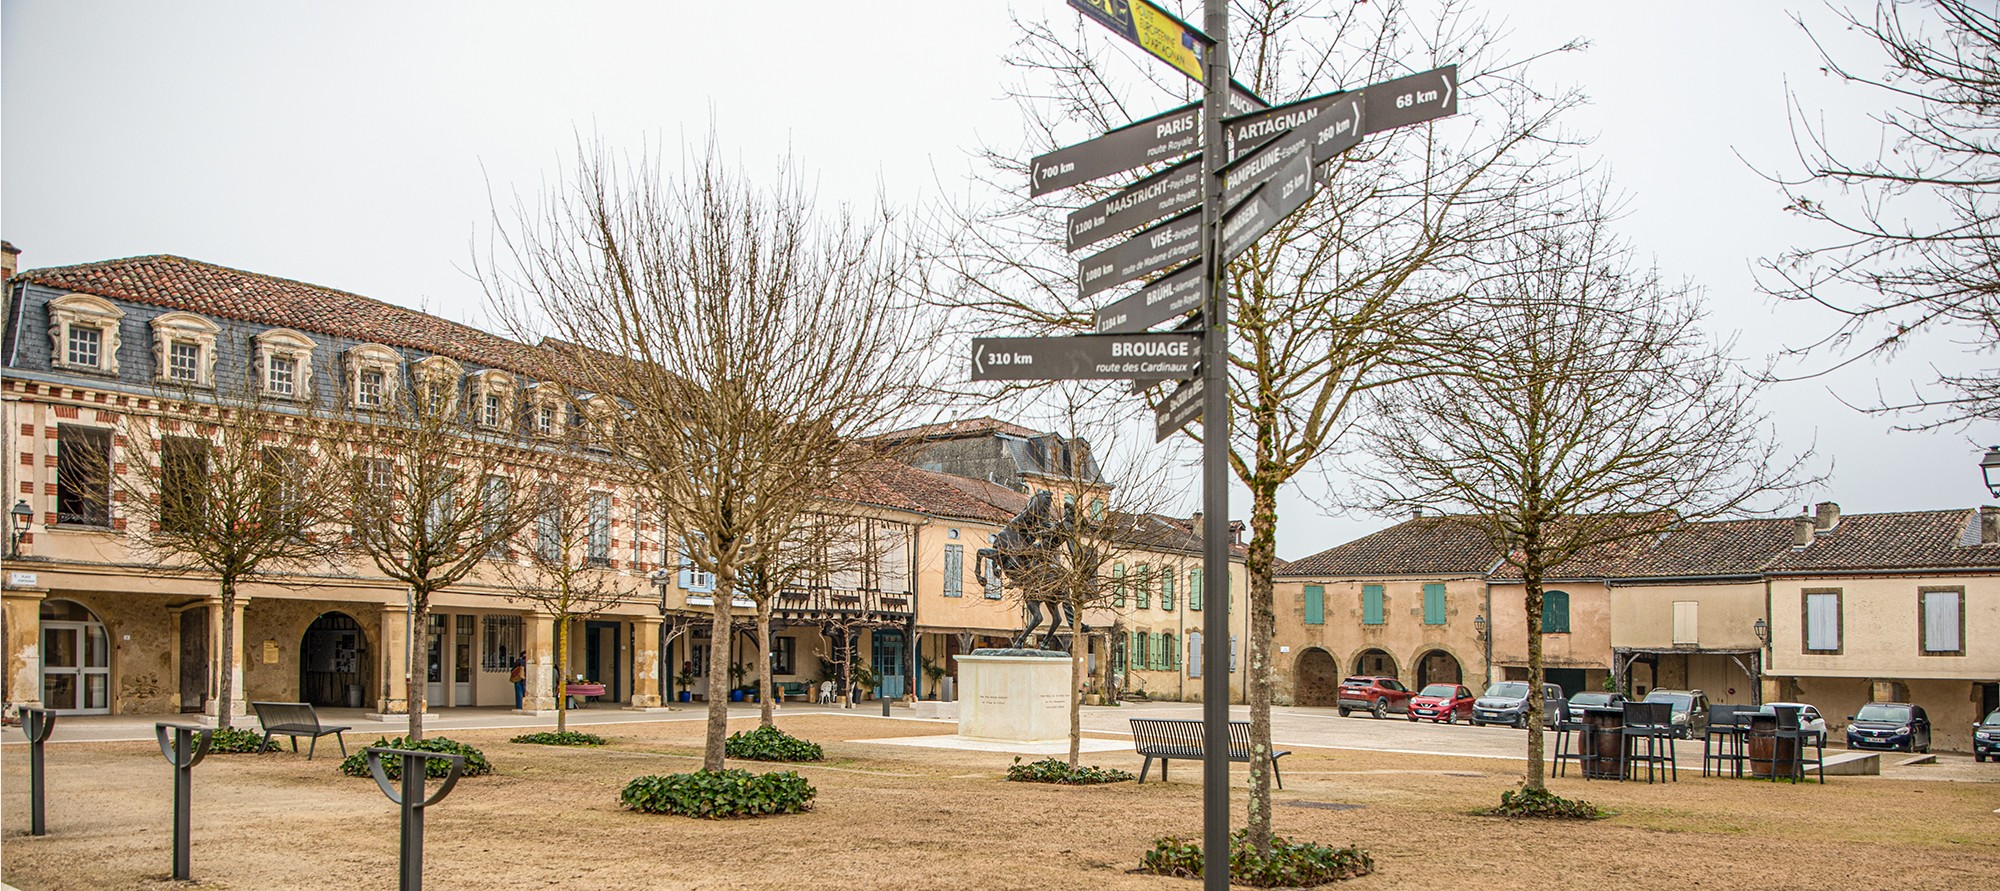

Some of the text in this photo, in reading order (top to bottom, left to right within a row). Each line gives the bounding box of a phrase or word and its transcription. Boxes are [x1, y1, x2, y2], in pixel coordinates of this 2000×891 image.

[1230, 93, 1253, 114] AUCH
[1396, 90, 1437, 109] 68 km
[1156, 115, 1194, 139] PARIS
[1238, 107, 1319, 141] ARTAGNAN
[1317, 118, 1350, 145] 260 km
[1147, 136, 1194, 157] route Royale
[1041, 162, 1075, 180] 700 km
[1282, 179, 1294, 200] 125
[1294, 174, 1305, 189] km
[1158, 188, 1197, 210] route Royale
[1075, 214, 1105, 236] 1100 km
[1102, 264, 1114, 275] km
[1122, 265, 1136, 277] route
[1136, 260, 1143, 271] de
[1144, 252, 1167, 268] Madame
[1117, 314, 1127, 325] km
[988, 352, 1033, 366] 310 km
[1112, 341, 1189, 357] BROUAGE
[1096, 362, 1188, 373] route des Cardinaux
